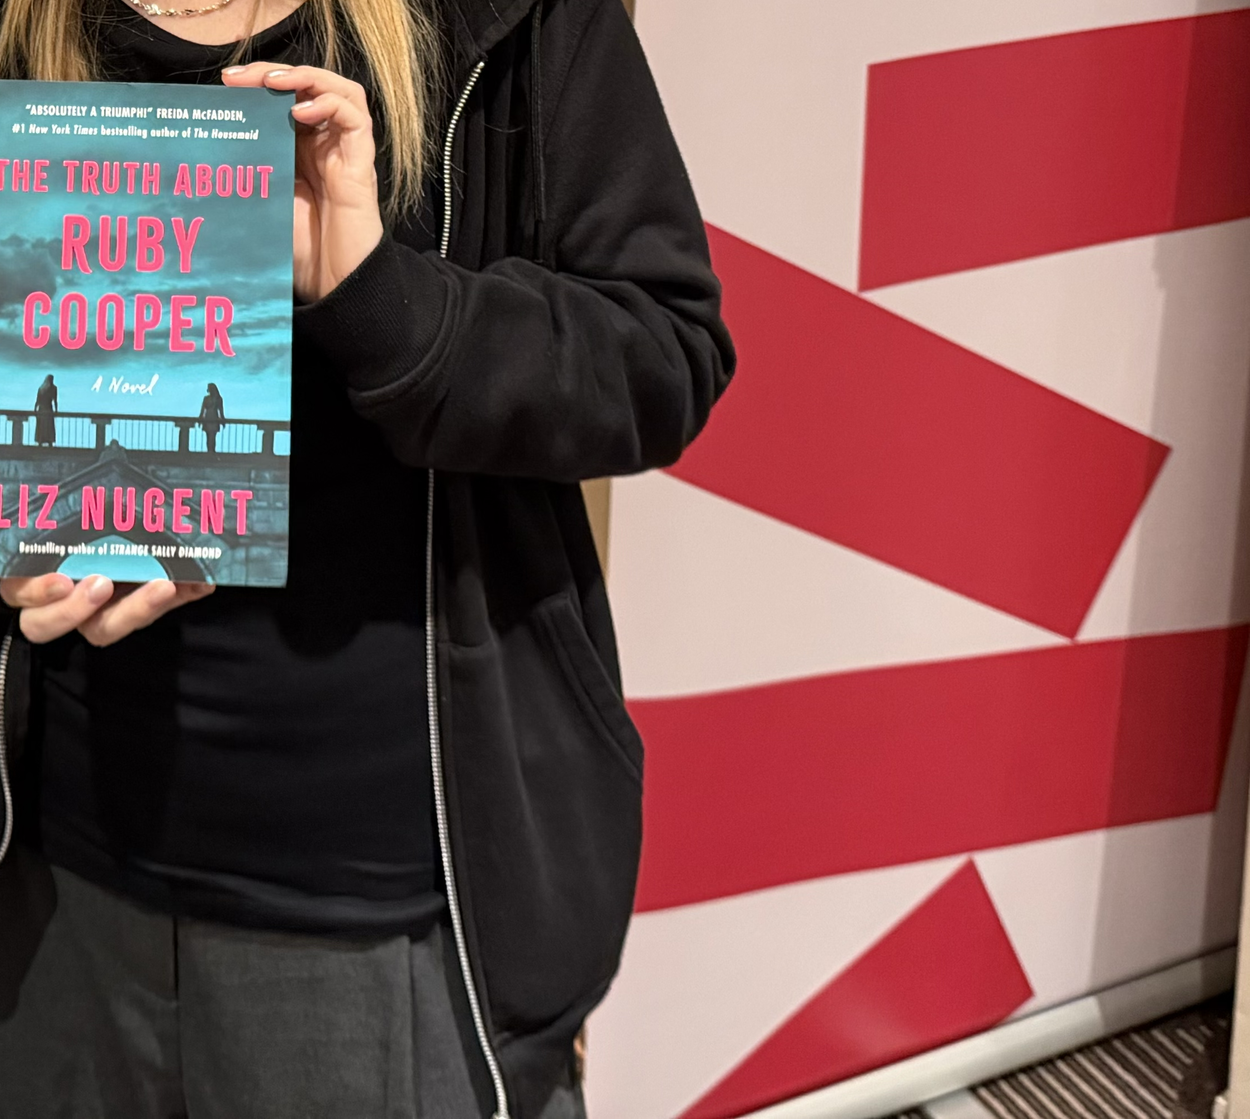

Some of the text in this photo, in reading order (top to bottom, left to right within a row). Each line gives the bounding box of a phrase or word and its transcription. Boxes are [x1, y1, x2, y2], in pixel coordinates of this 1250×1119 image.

[89, 106, 97, 117] A
[156, 108, 189, 120] FREIDA
[192, 108, 247, 123] McFADDEN,
[12, 124, 259, 140] #1 New York Times bestselling author of The Housemaid
[63, 160, 161, 196] TRUTH
[173, 163, 274, 199] ABOUT
[61, 214, 205, 274] RUBY
[22, 290, 236, 358] COOPER
[91, 373, 160, 396] A Novel
[81, 485, 253, 536] NUGENT
[19, 541, 222, 560] Bestselling author of STRANGE SALLY DIAMOND
